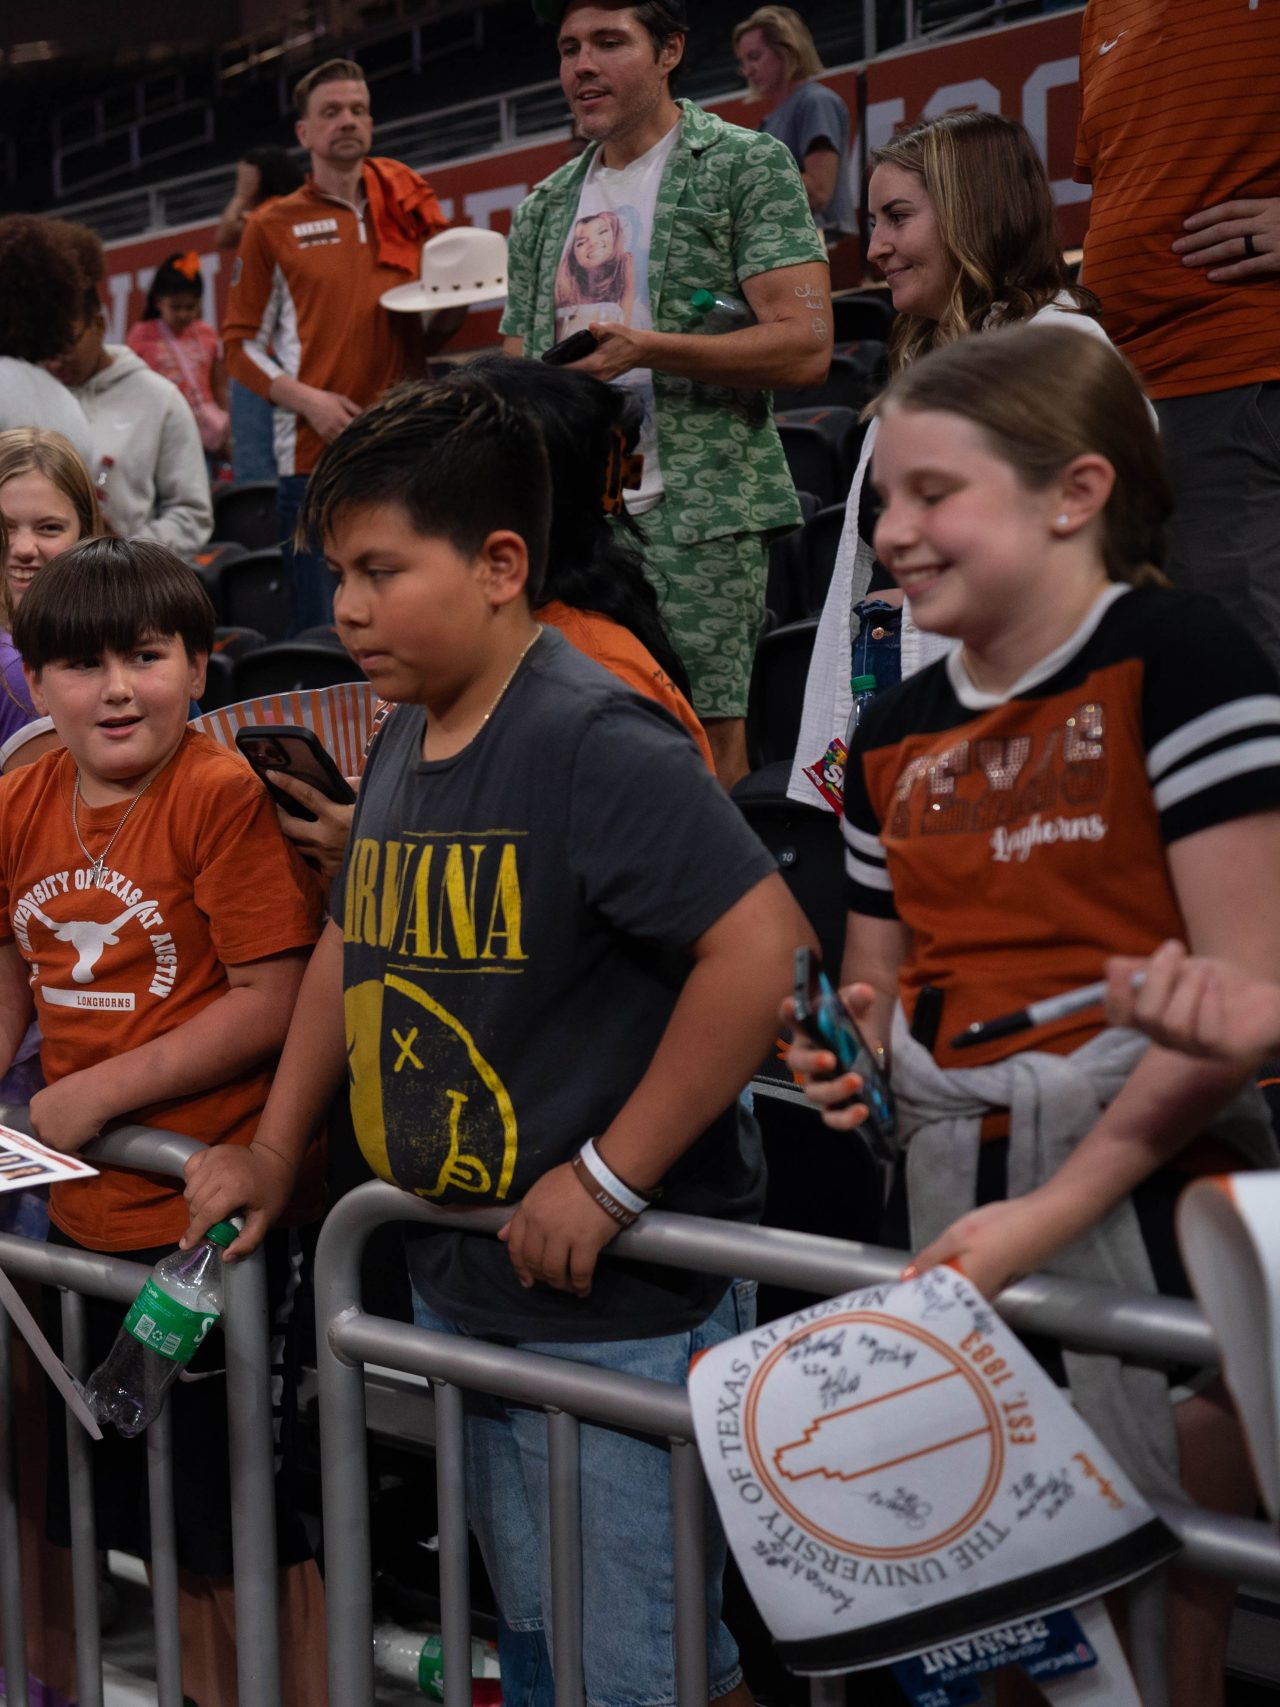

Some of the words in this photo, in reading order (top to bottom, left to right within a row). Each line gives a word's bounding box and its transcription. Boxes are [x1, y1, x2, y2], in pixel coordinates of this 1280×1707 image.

[782, 852, 794, 862] 10
[343, 837, 530, 960] IRVANA
[148, 932, 178, 999] AUSTIN
[76, 995, 132, 1009] LONGHORNS
[790, 1287, 891, 1331] AUSTIN
[751, 1324, 779, 1360] AT
[959, 1329, 1015, 1387] 1883
[717, 1358, 752, 1460] TEXAS
[728, 1467, 764, 1504] OF
[757, 1509, 948, 1587] UNIVERSITY
[948, 1520, 1012, 1561] THE
[921, 1619, 1051, 1676] PENNANT
